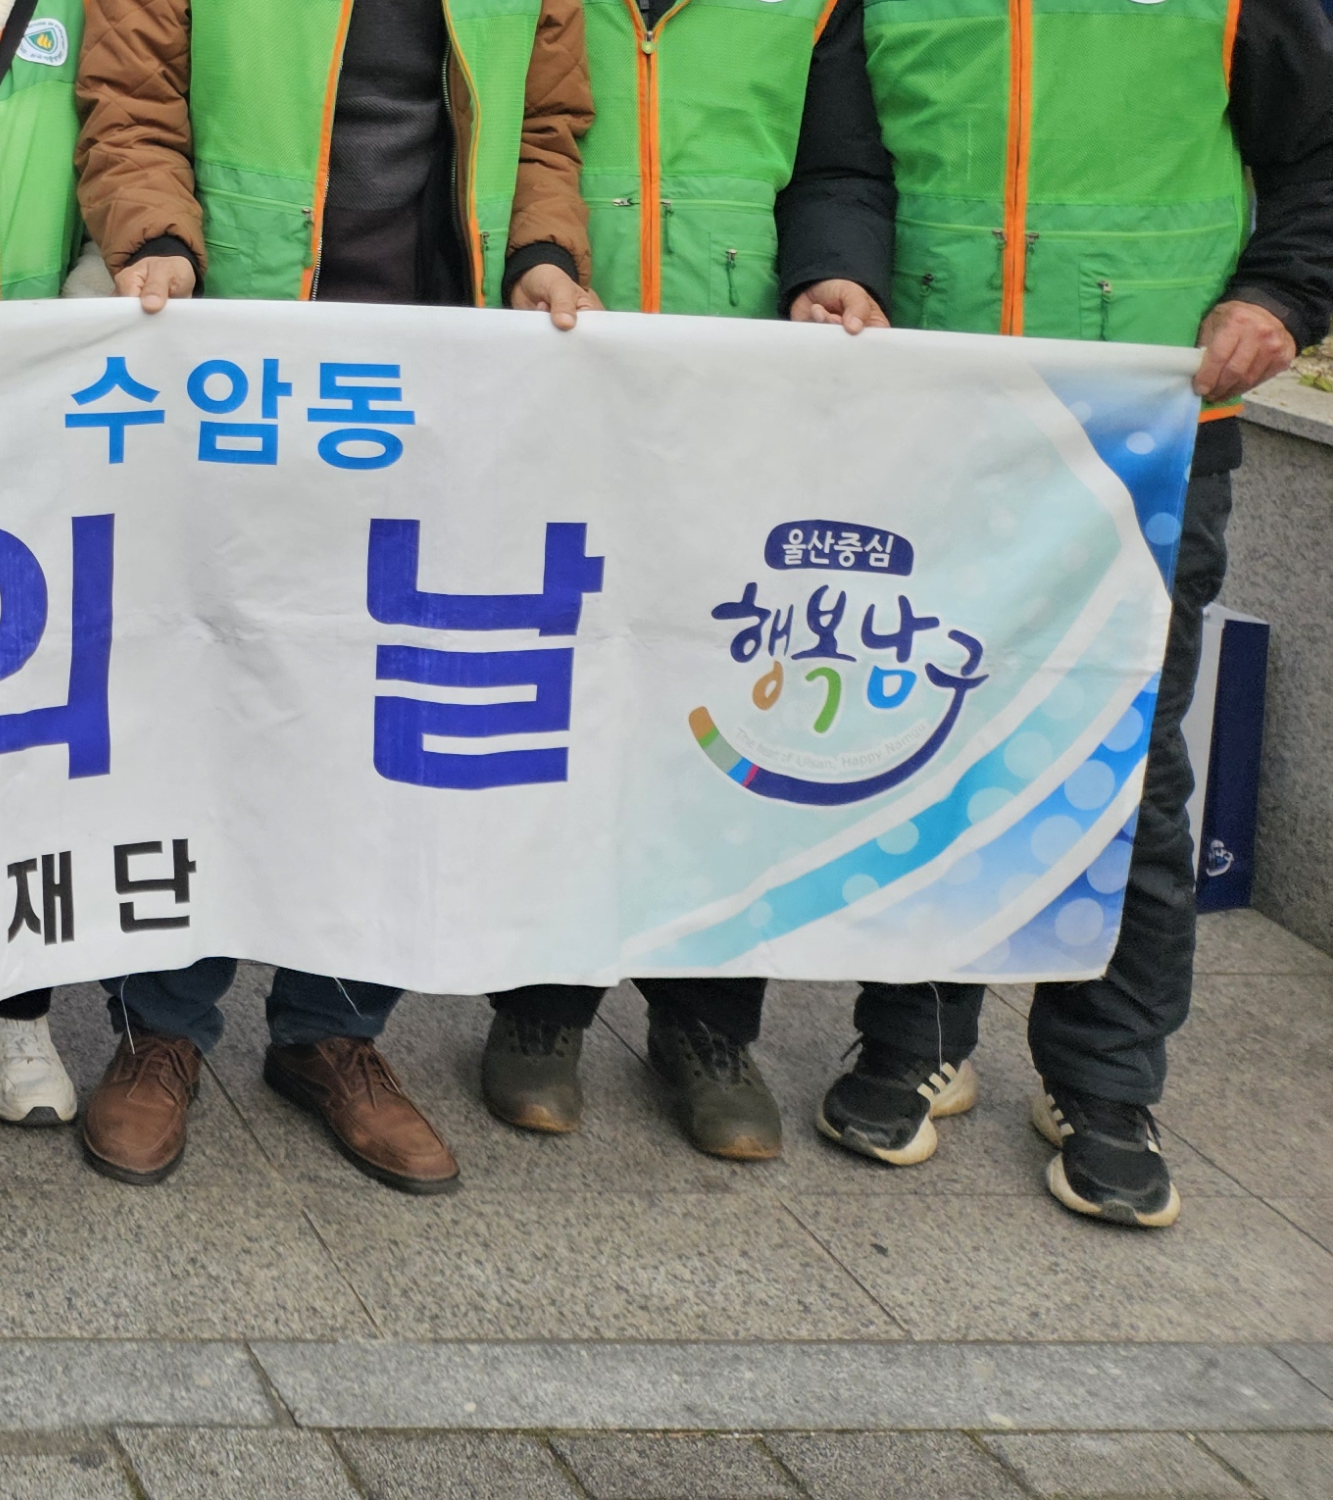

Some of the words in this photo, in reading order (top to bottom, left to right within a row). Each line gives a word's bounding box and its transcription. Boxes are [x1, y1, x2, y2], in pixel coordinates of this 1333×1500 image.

[64, 356, 416, 471] 수암동
[782, 528, 894, 568] 울산중심
[366, 517, 605, 790] 날
[711, 581, 989, 740] 행복남구
[841, 749, 882, 768] Happy
